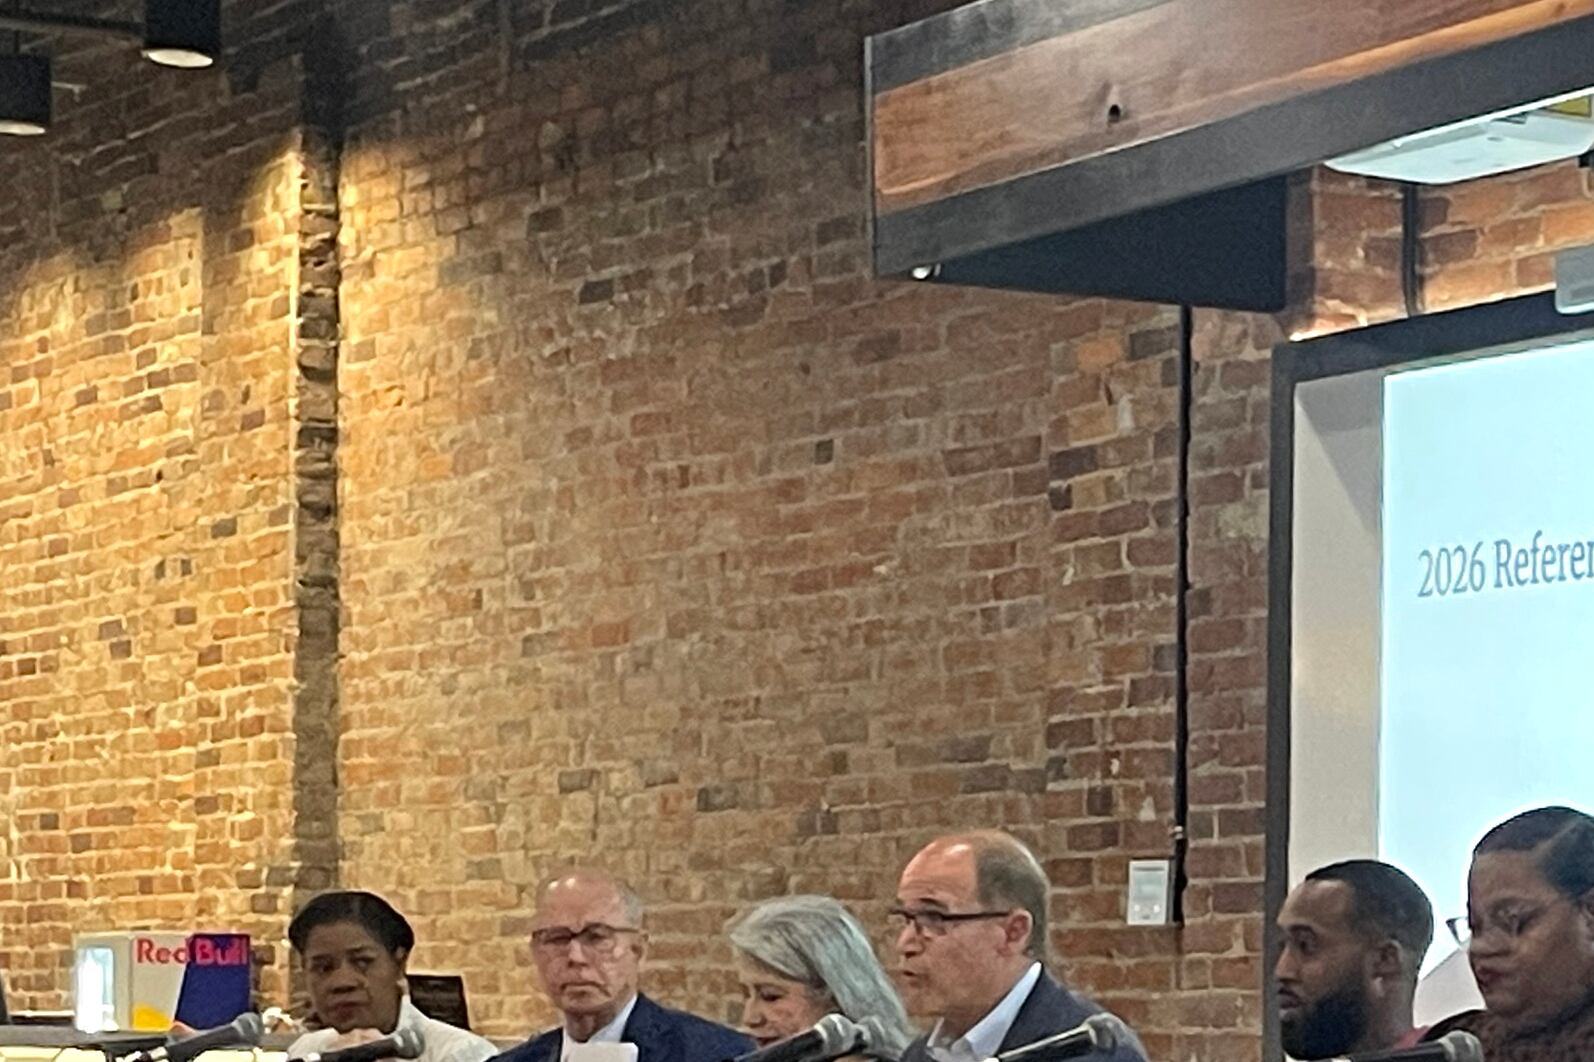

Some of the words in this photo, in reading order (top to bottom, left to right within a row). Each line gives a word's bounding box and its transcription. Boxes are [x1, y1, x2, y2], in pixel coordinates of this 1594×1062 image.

[1417, 541, 1485, 597] 2026
[137, 938, 192, 965] Red
[195, 937, 248, 966] Bull
